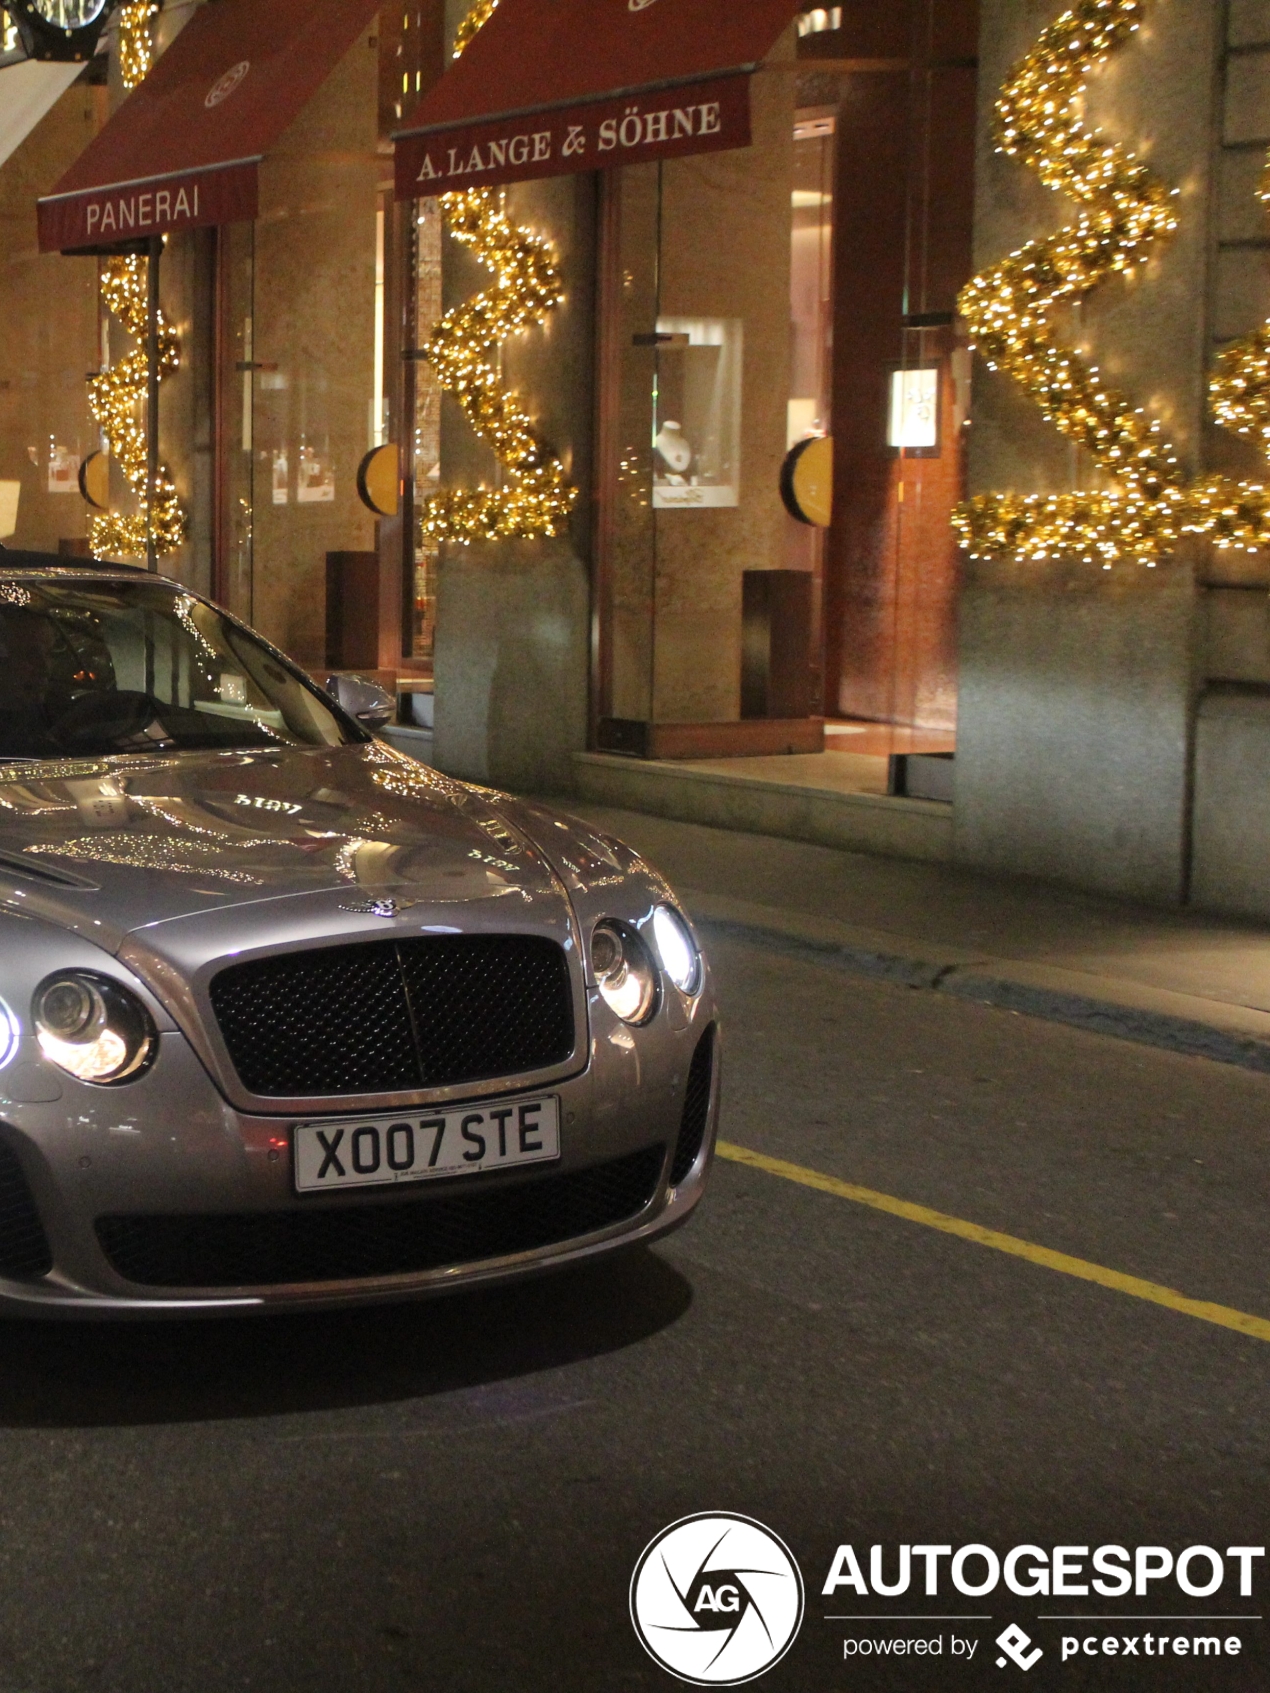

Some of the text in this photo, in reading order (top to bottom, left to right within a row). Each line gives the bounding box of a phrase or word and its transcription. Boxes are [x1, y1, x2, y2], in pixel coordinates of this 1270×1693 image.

[447, 131, 551, 176] LANGE
[562, 125, 585, 157] &
[598, 101, 721, 151] SÖHNE
[87, 184, 199, 235] PANERAI
[461, 1103, 543, 1162] STE
